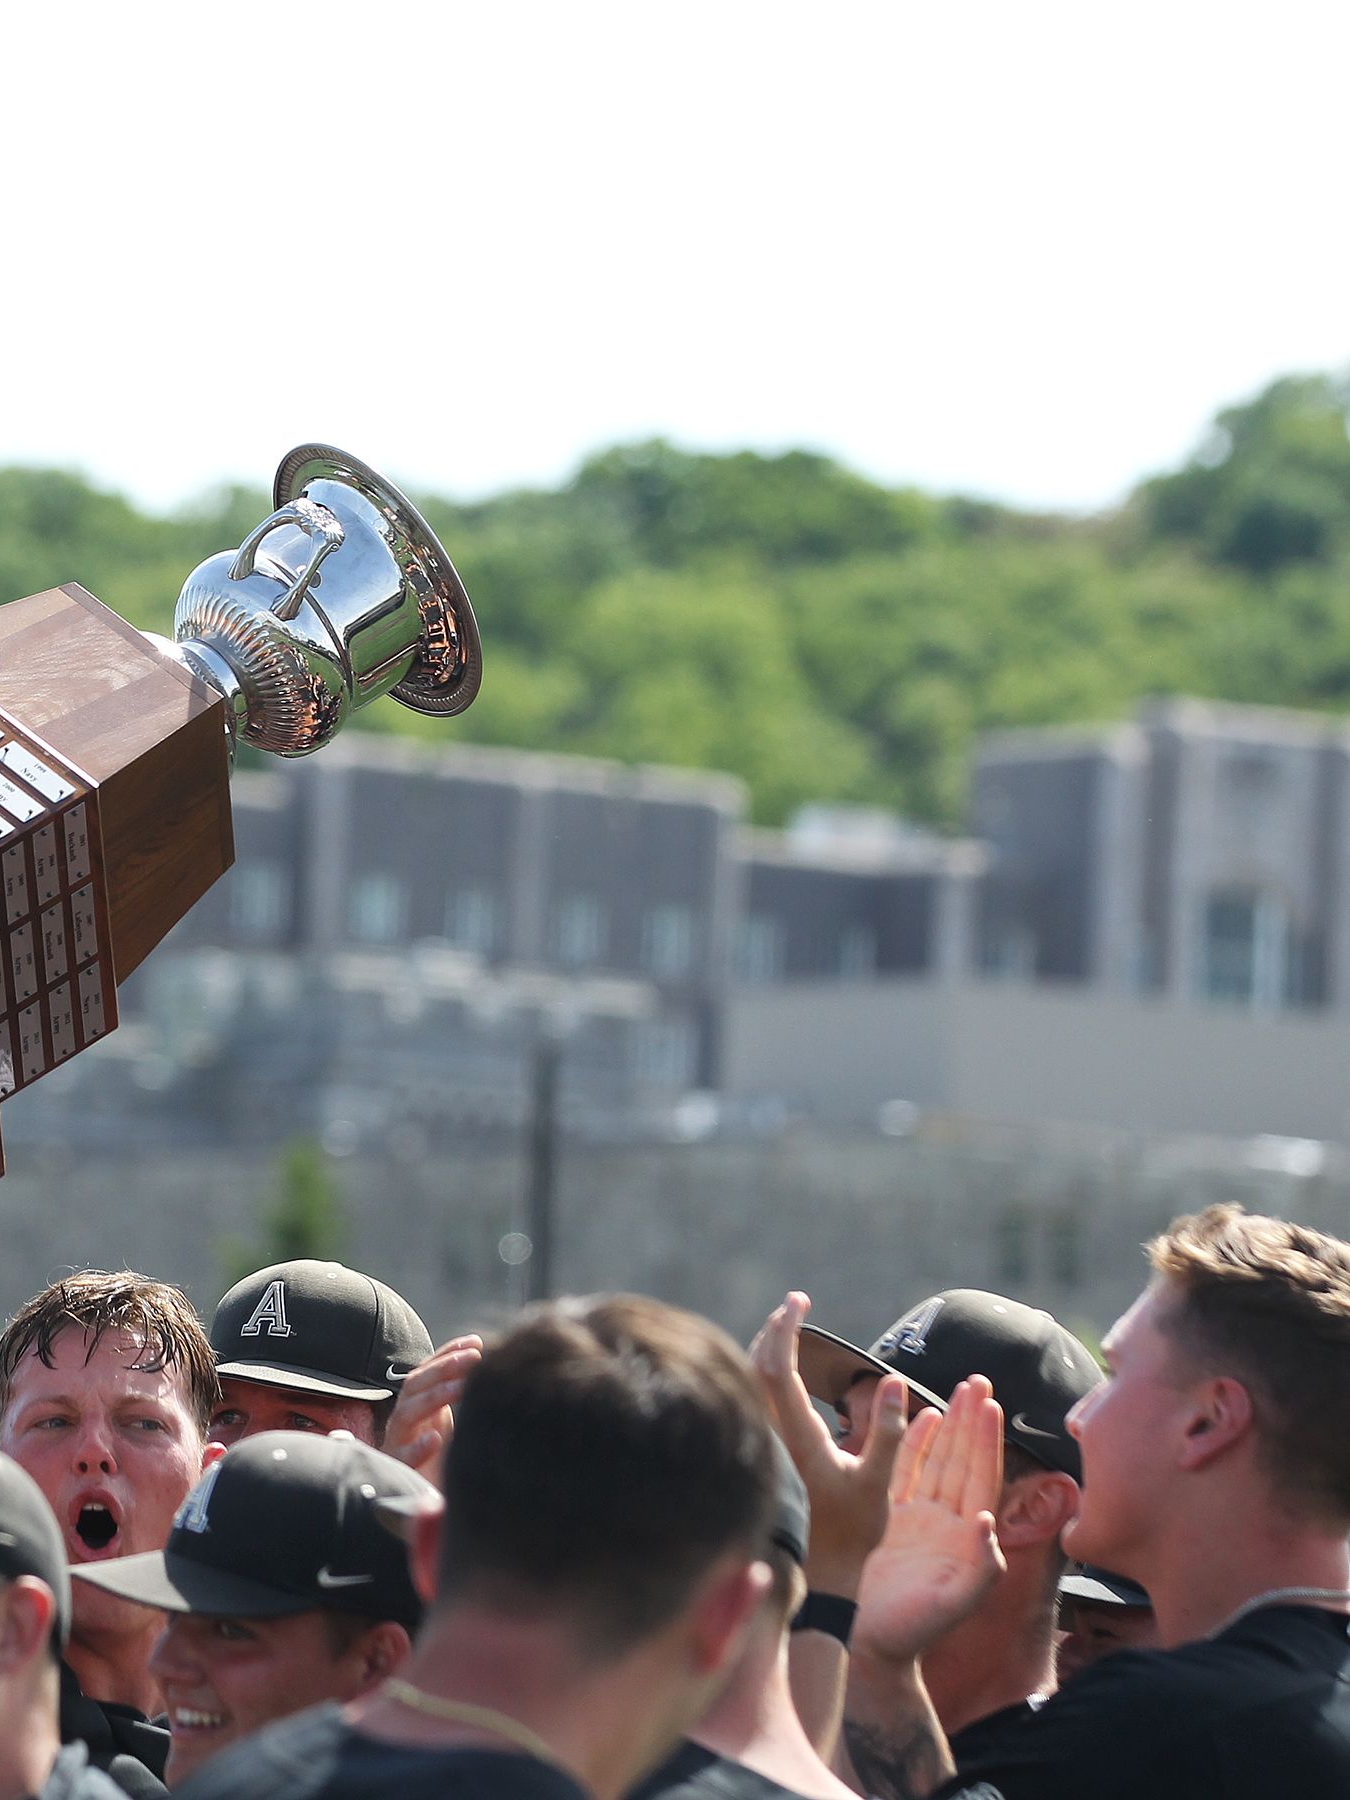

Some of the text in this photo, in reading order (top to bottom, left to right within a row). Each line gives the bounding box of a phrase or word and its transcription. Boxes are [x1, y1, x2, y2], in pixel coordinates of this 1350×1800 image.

[21, 768, 38, 781] Navy
[34, 763, 47, 773] 1999
[2, 782, 15, 793] 2000
[68, 831, 76, 862] Bucknell
[241, 1281, 291, 1337] A
[879, 1296, 946, 1356] A
[173, 1461, 222, 1533] A
